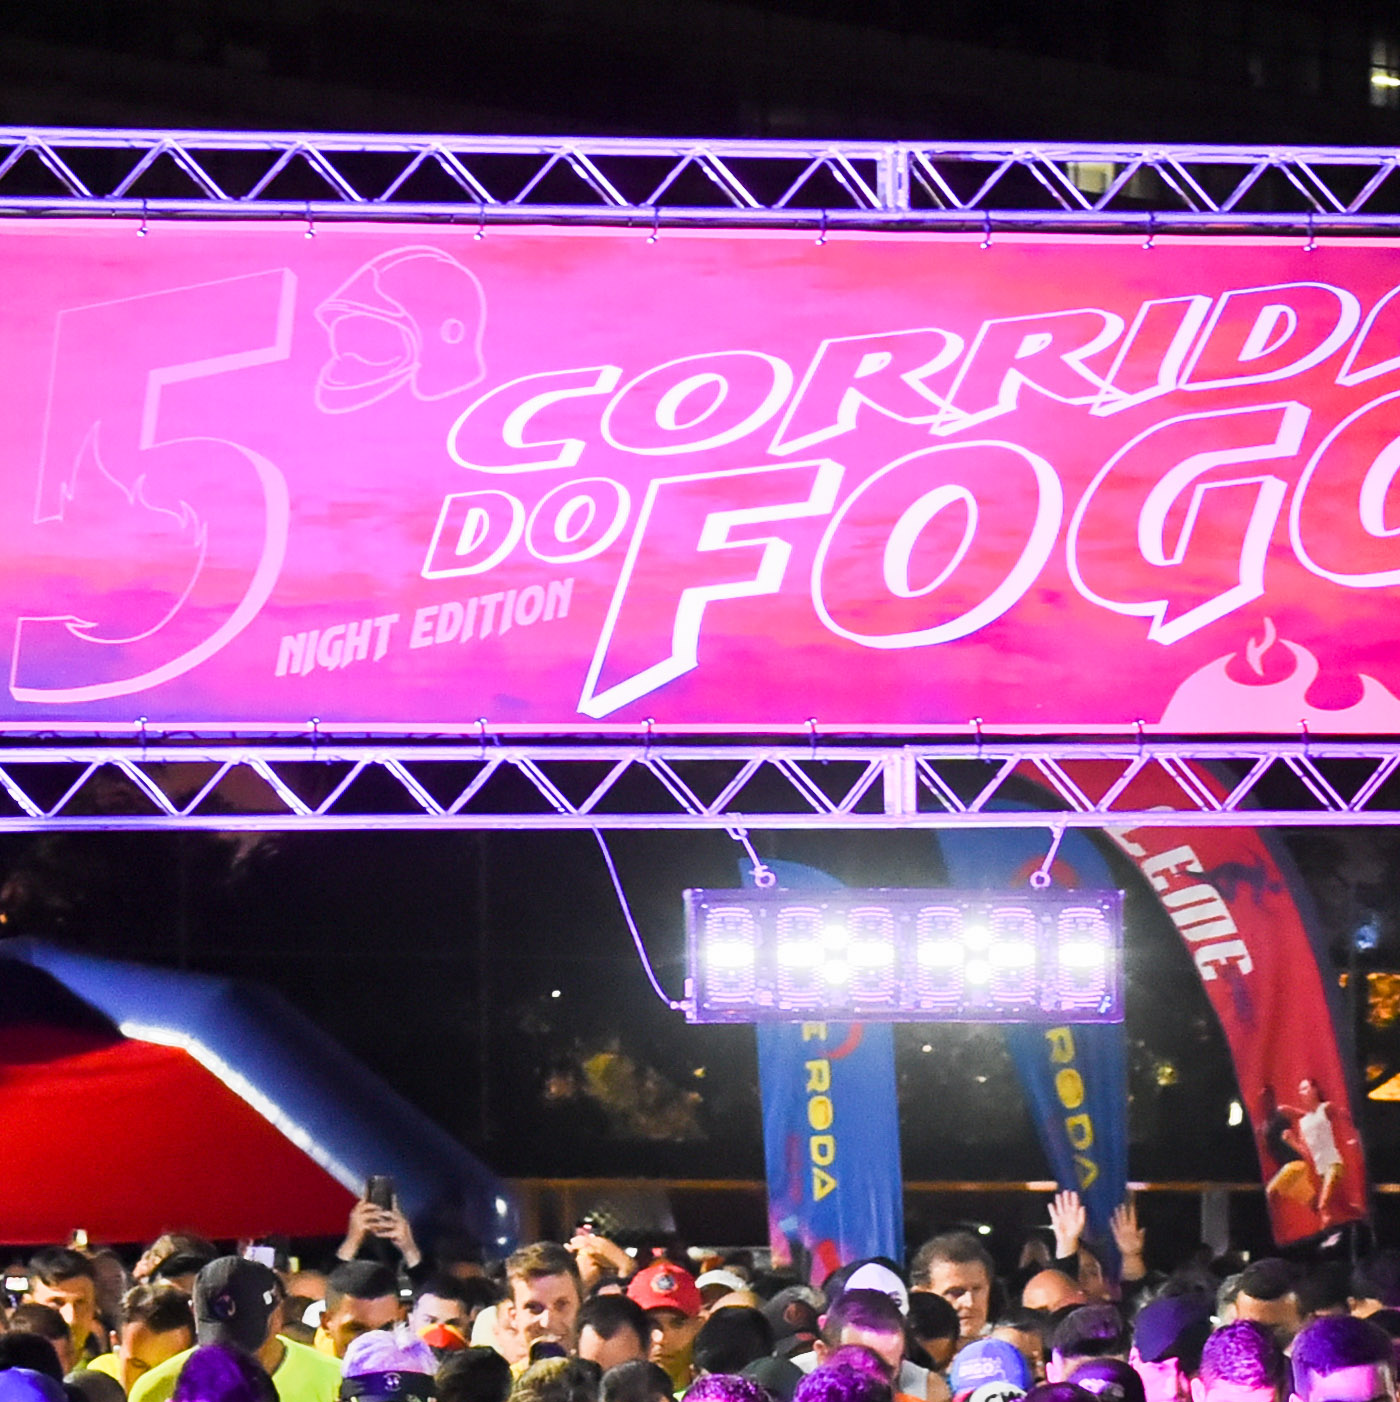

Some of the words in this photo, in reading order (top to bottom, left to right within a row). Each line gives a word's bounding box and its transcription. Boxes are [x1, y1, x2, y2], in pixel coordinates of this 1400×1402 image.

[421, 476, 630, 579] DO
[275, 611, 399, 677] NIGHT
[410, 577, 574, 650] EDITION
[805, 1059, 837, 1201] RODA
[1045, 1026, 1098, 1190] RODA
